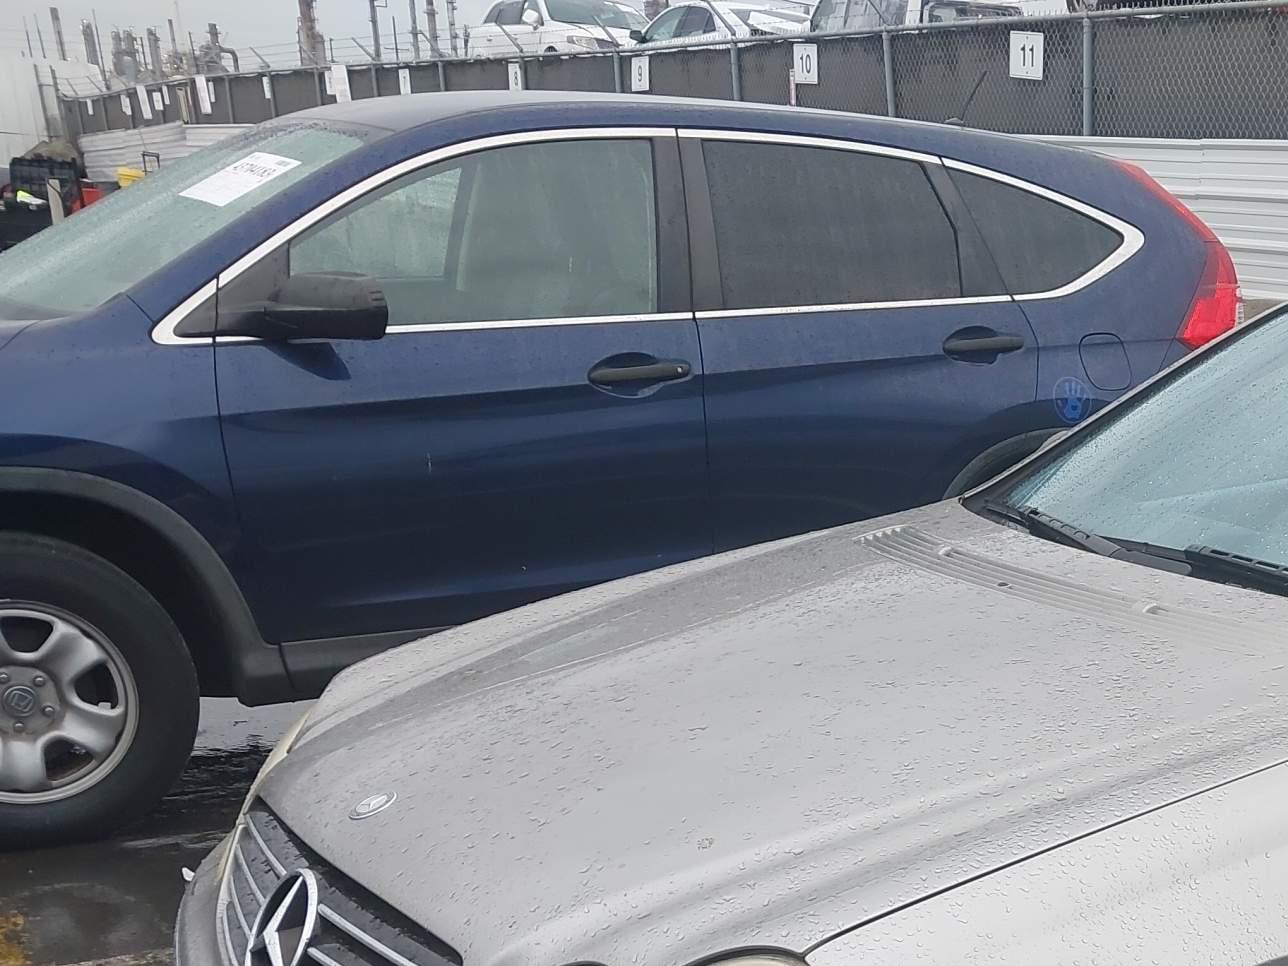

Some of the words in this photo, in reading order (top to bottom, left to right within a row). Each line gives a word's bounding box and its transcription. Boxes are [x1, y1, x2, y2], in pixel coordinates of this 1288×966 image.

[799, 53, 812, 74] 10
[1020, 44, 1034, 67] 11
[512, 71, 519, 87] 8
[636, 65, 644, 83] 9
